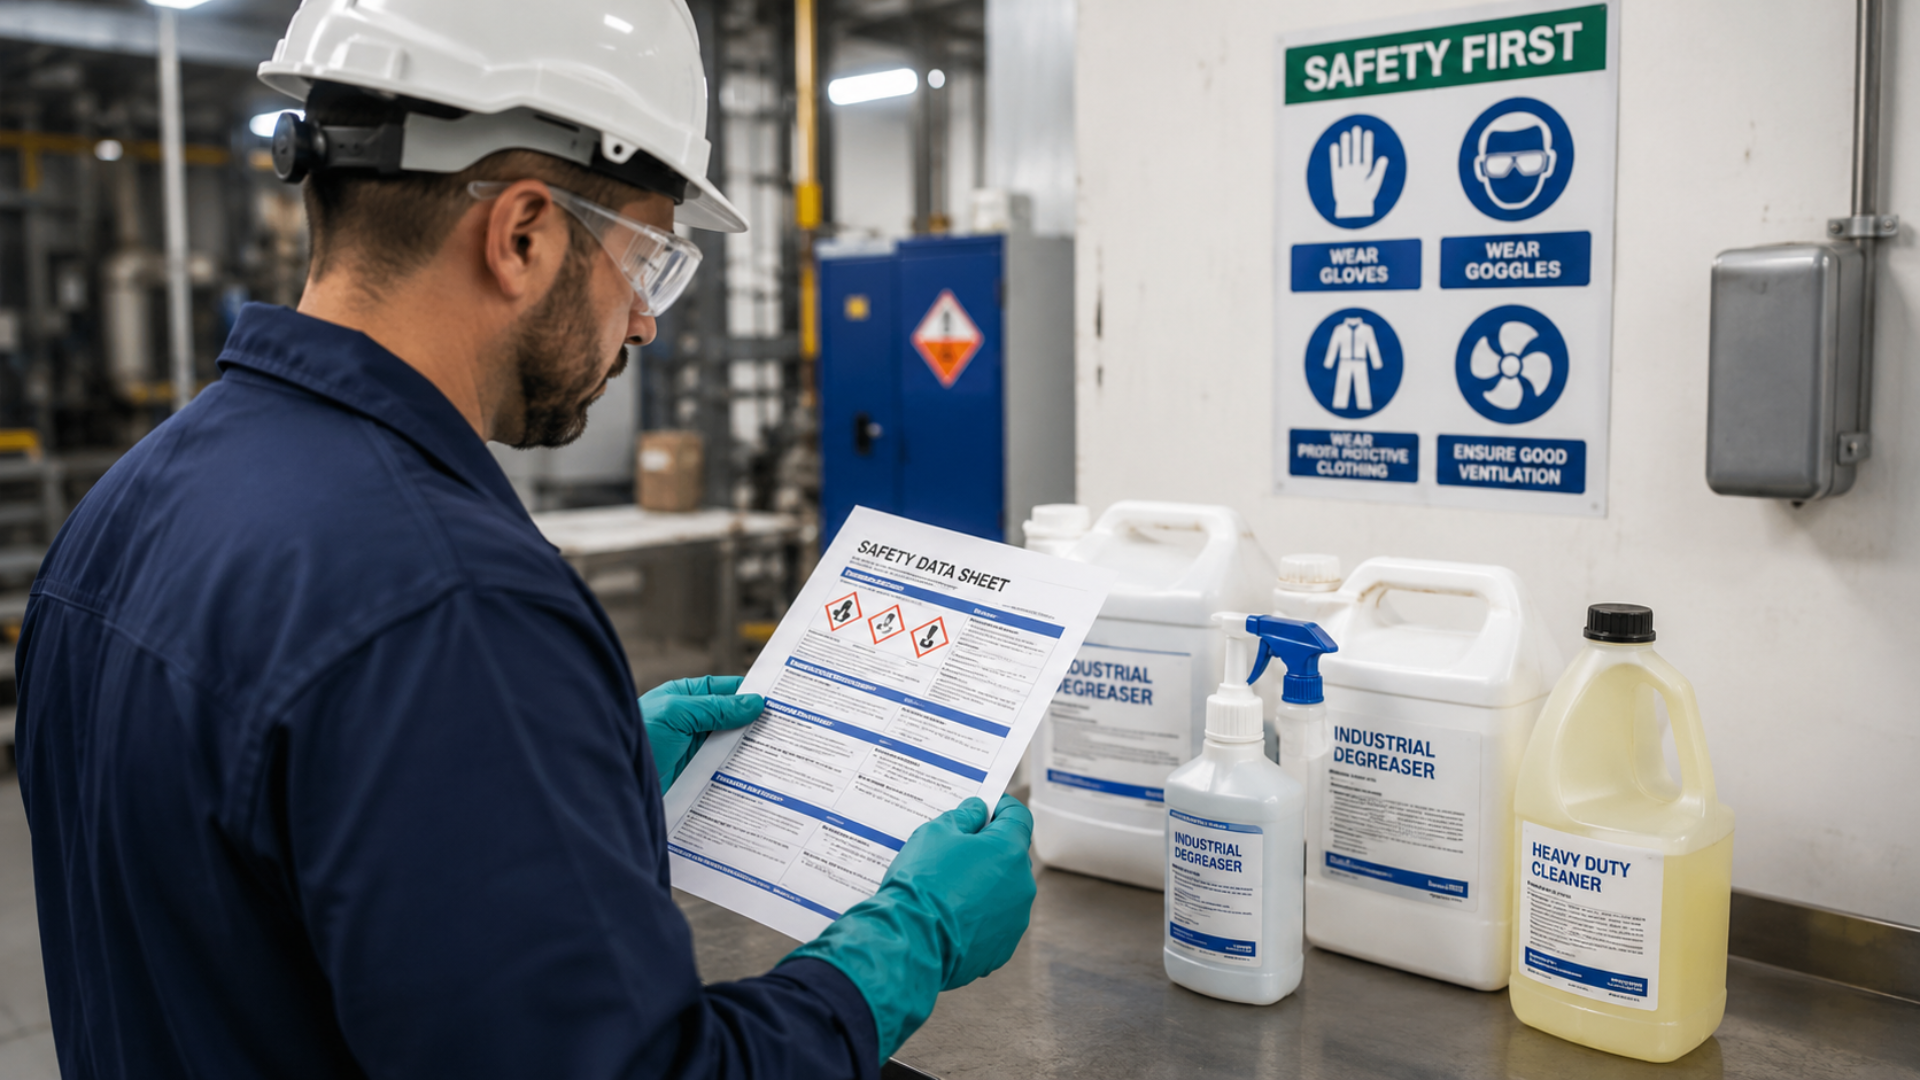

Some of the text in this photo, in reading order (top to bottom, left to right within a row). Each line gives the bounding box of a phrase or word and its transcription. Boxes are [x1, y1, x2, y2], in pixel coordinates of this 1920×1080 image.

[1304, 21, 1583, 92] SAFETY FIRST
[1329, 247, 1379, 265] WEAR
[1485, 241, 1540, 259] WEAR
[1319, 265, 1388, 285] GLOVES
[1465, 260, 1561, 280] GOGGLES
[1330, 433, 1374, 447] WEAR
[1453, 443, 1568, 465] ENSURE GOOD
[1316, 460, 1388, 478] CLOTHING
[1458, 463, 1562, 486] VENTILATION
[857, 540, 916, 566] SAFETY
[915, 556, 956, 579] DATA
[958, 568, 1011, 592] SHEET
[1066, 658, 1153, 684] DUSTRIAL
[1334, 726, 1436, 758] INDUSTRIAL
[1334, 746, 1435, 780] DEGREASER
[1175, 831, 1242, 857] INDUSTRIAL
[1175, 846, 1242, 873] DEGREASER
[1532, 842, 1631, 878] HEAVY DUTY
[1532, 861, 1602, 893] CLEANER
